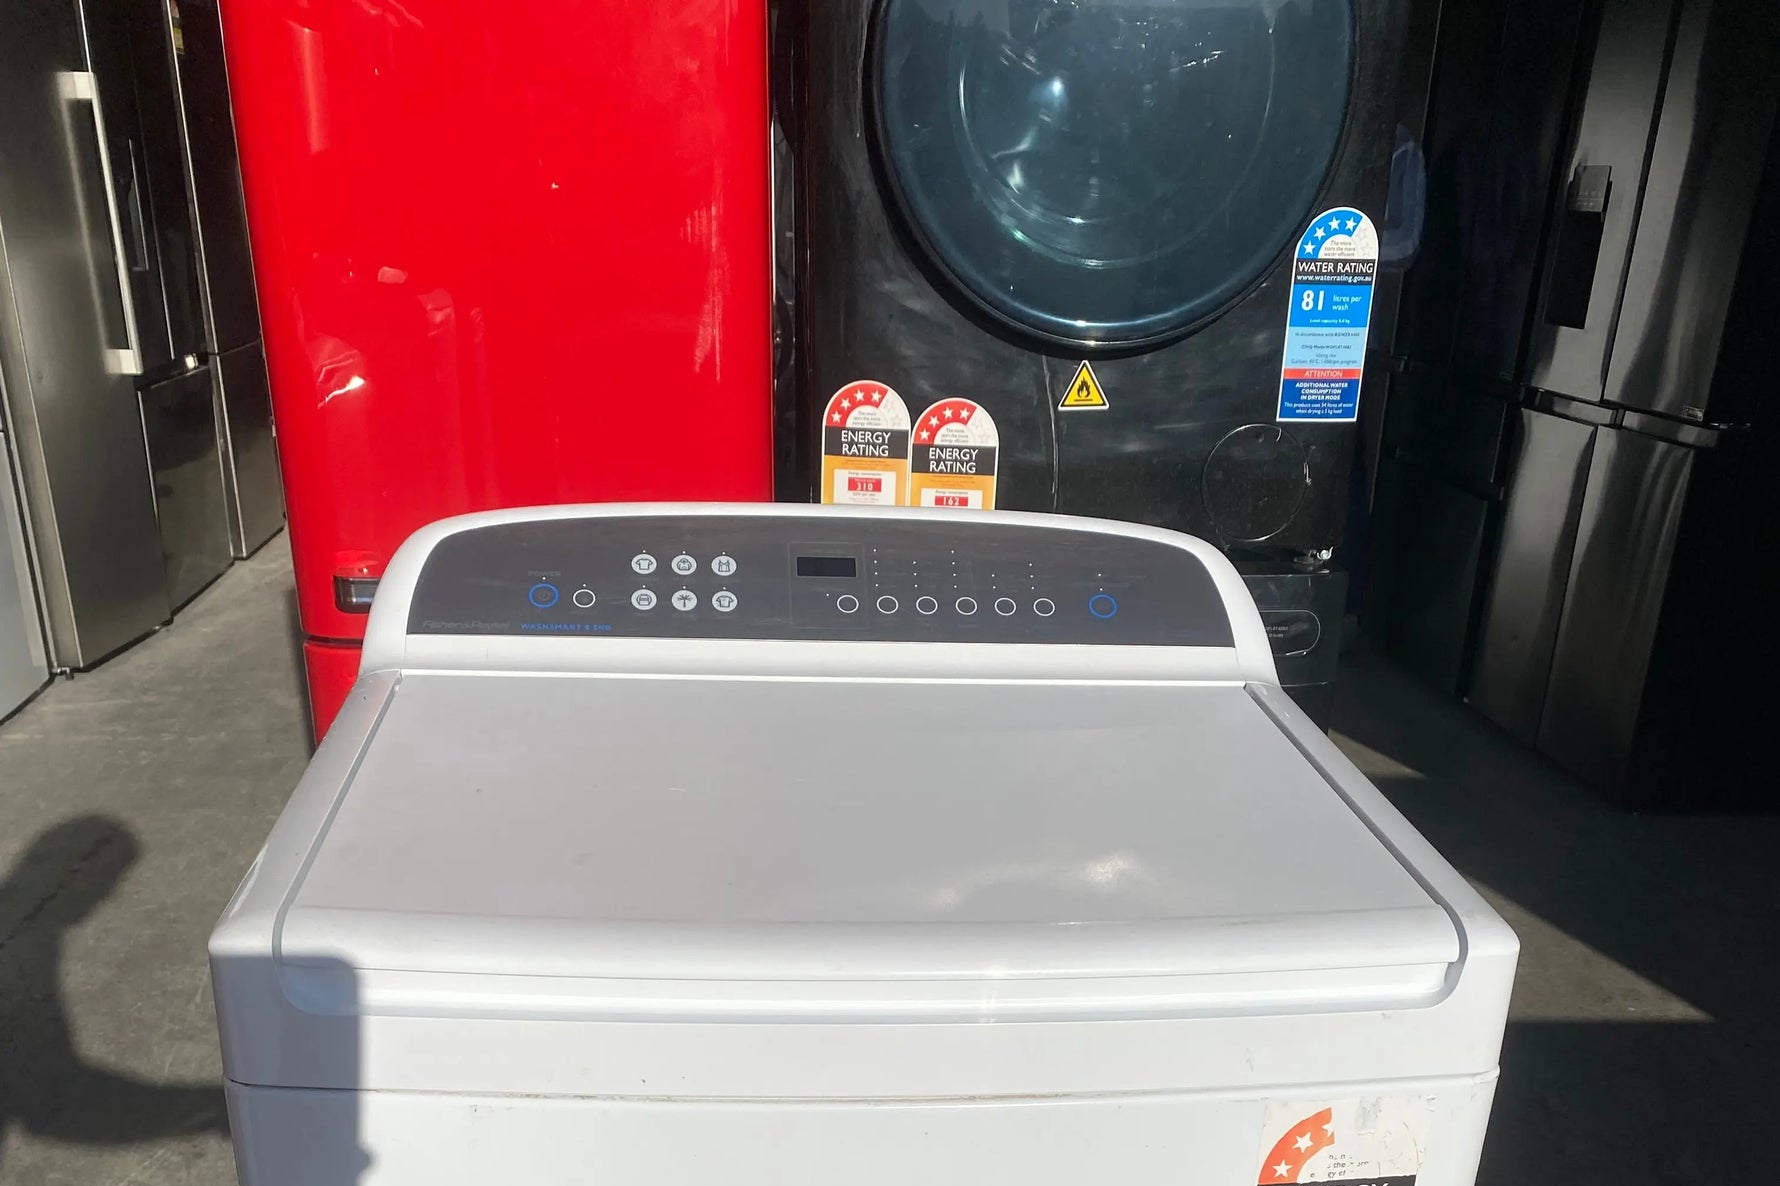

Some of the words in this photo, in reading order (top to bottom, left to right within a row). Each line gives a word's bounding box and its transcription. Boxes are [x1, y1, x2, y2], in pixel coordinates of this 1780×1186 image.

[1298, 261, 1334, 273] WATER
[1337, 262, 1373, 273] RATING
[1297, 274, 1372, 283] www.waterrating.gov.au
[1301, 290, 1325, 311] 81
[1333, 294, 1350, 302] litres
[841, 430, 891, 444] ENERGY
[842, 444, 889, 457] RATING
[929, 447, 979, 460] ENERGY
[929, 461, 976, 473] RATING
[856, 482, 873, 491] 310
[943, 496, 960, 506] 162
